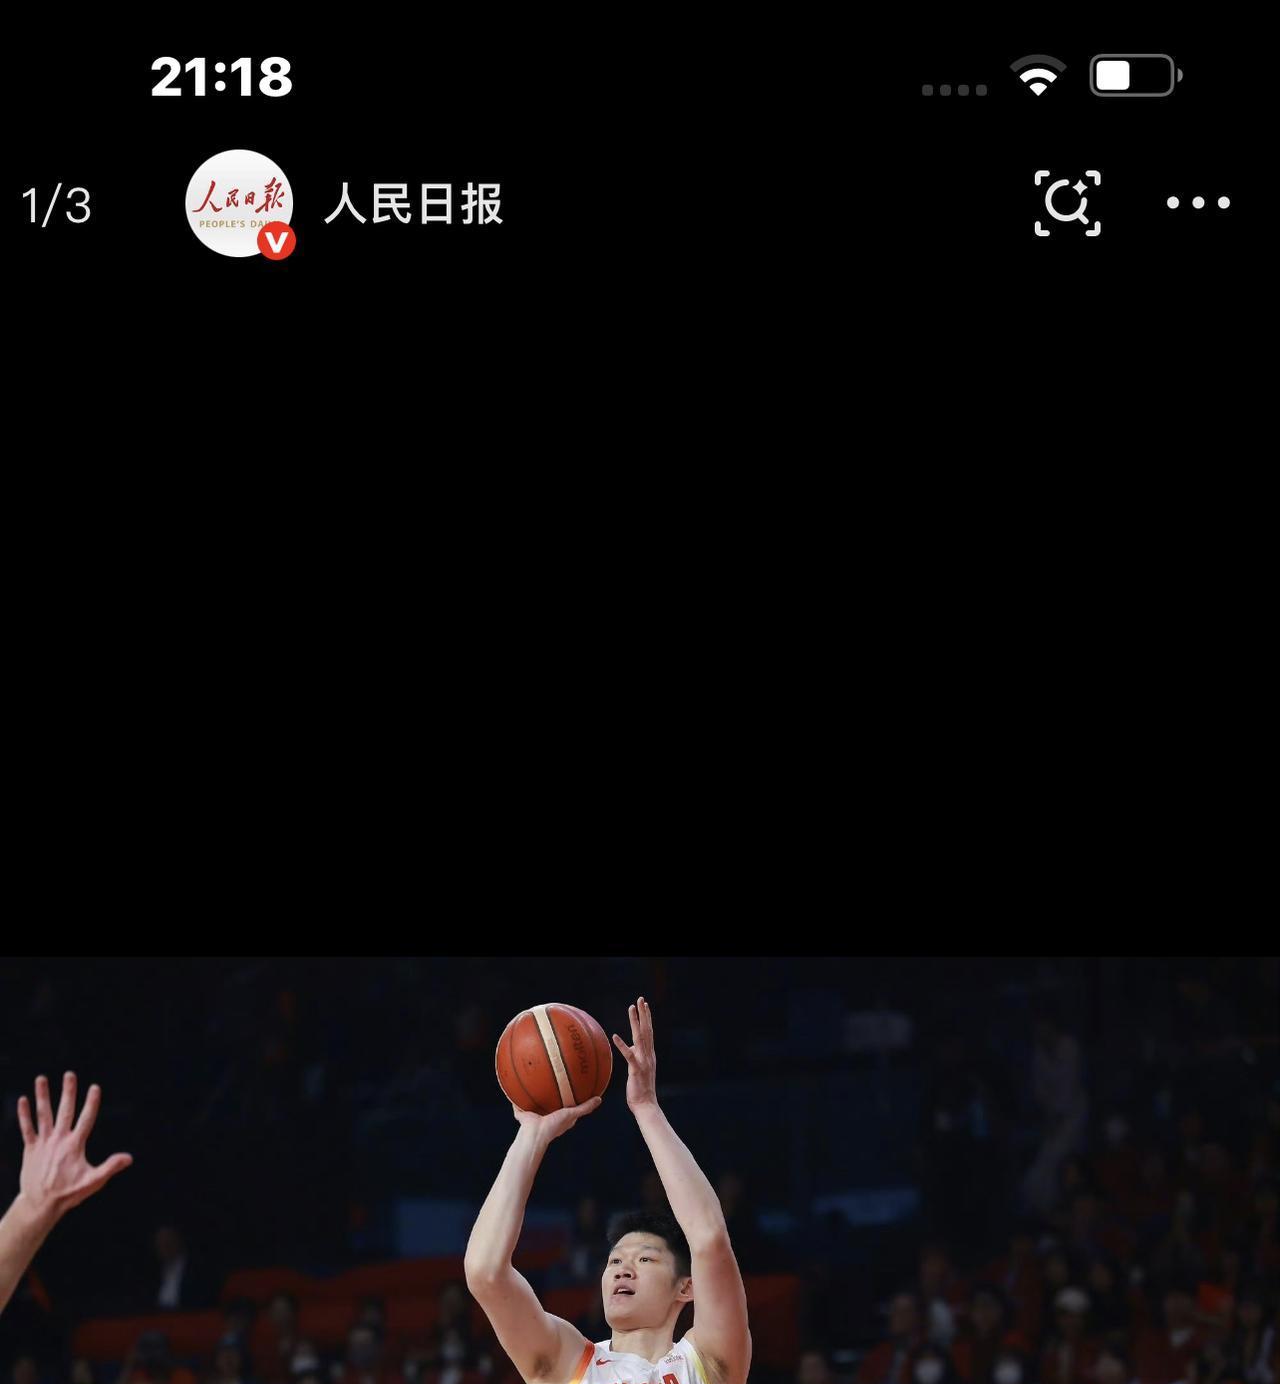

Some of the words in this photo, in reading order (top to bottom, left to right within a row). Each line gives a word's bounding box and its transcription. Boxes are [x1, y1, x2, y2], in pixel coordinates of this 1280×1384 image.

[151, 56, 293, 98] 21:18
[23, 183, 91, 227] 1/3
[199, 220, 246, 228] PEOPLE'S
[324, 182, 503, 224] 人民日报
